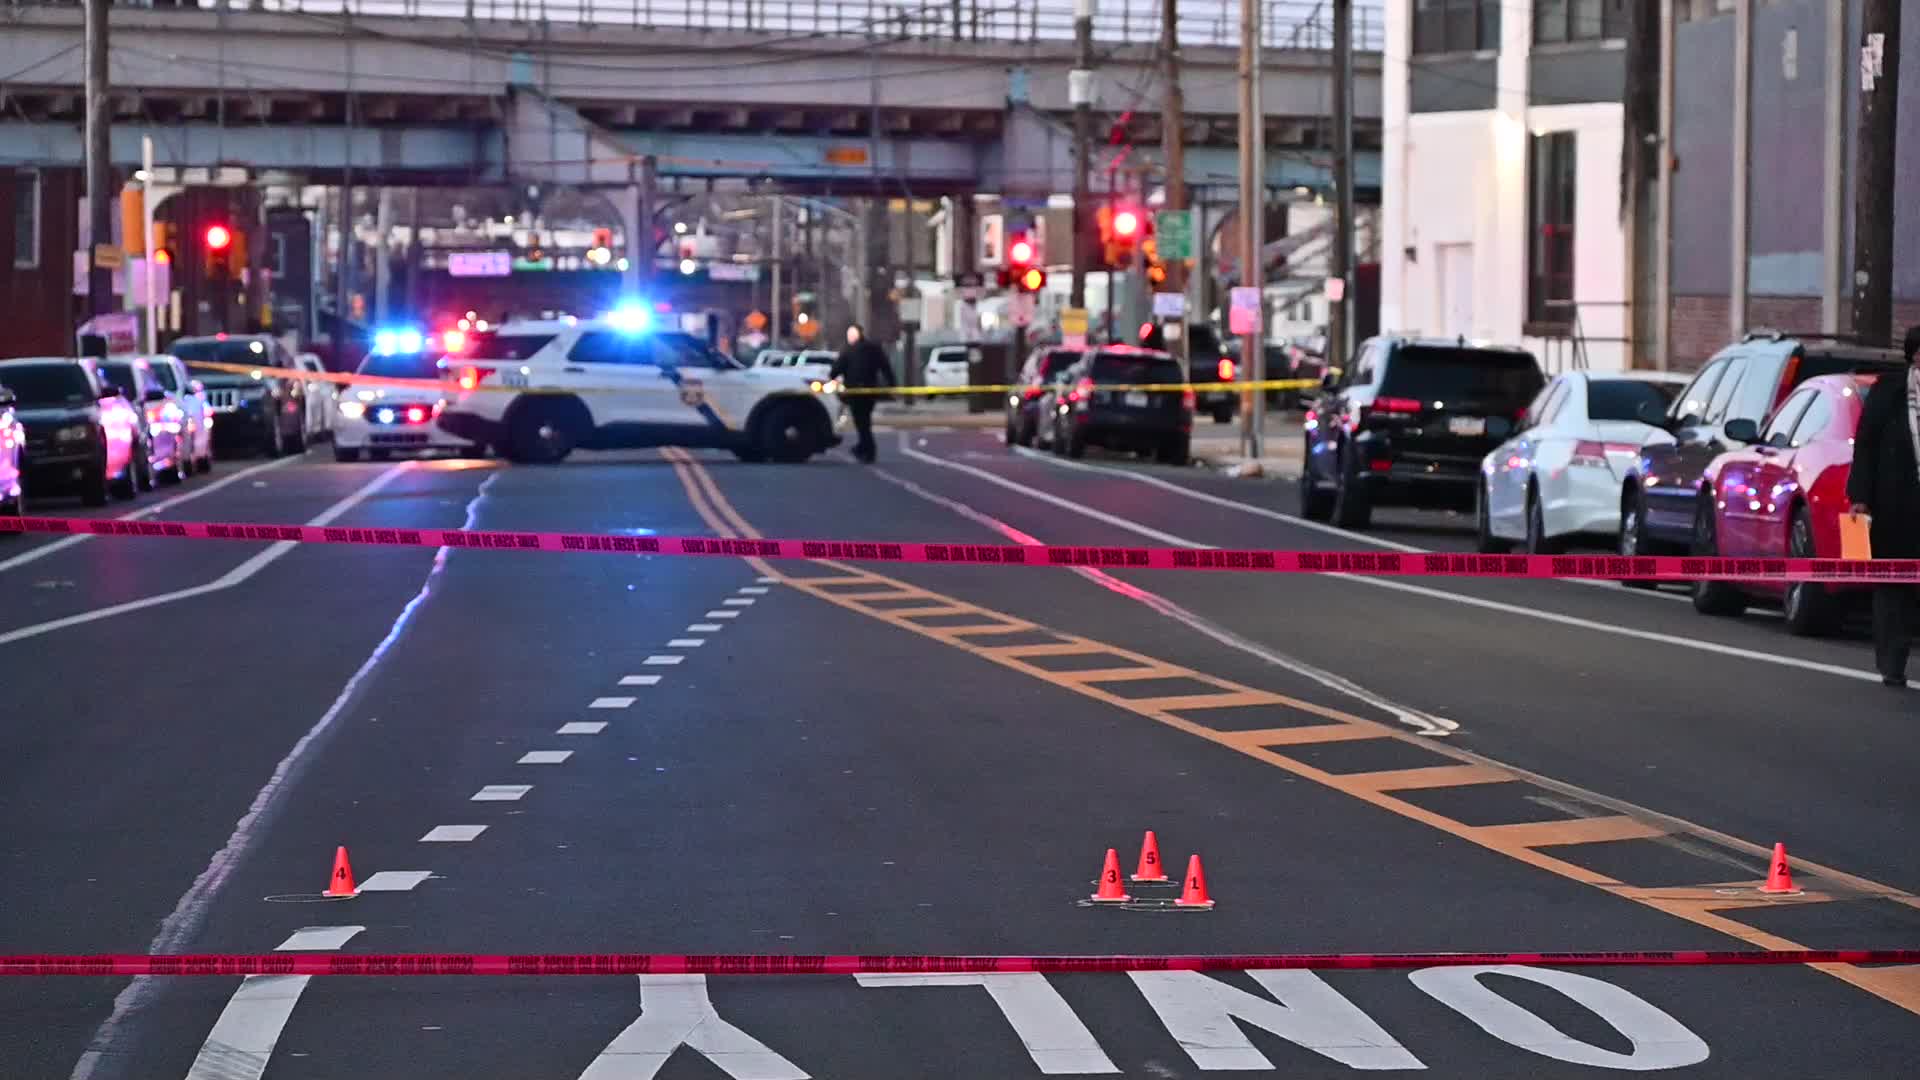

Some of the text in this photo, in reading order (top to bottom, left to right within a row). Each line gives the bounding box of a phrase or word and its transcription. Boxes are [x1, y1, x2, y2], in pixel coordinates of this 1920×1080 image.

[1146, 851, 1156, 864] 5
[335, 866, 346, 880] 4
[1107, 869, 1117, 883] 3
[1777, 862, 1788, 876] 2
[1191, 876, 1200, 889] 1
[578, 964, 1710, 1080] ONLY
